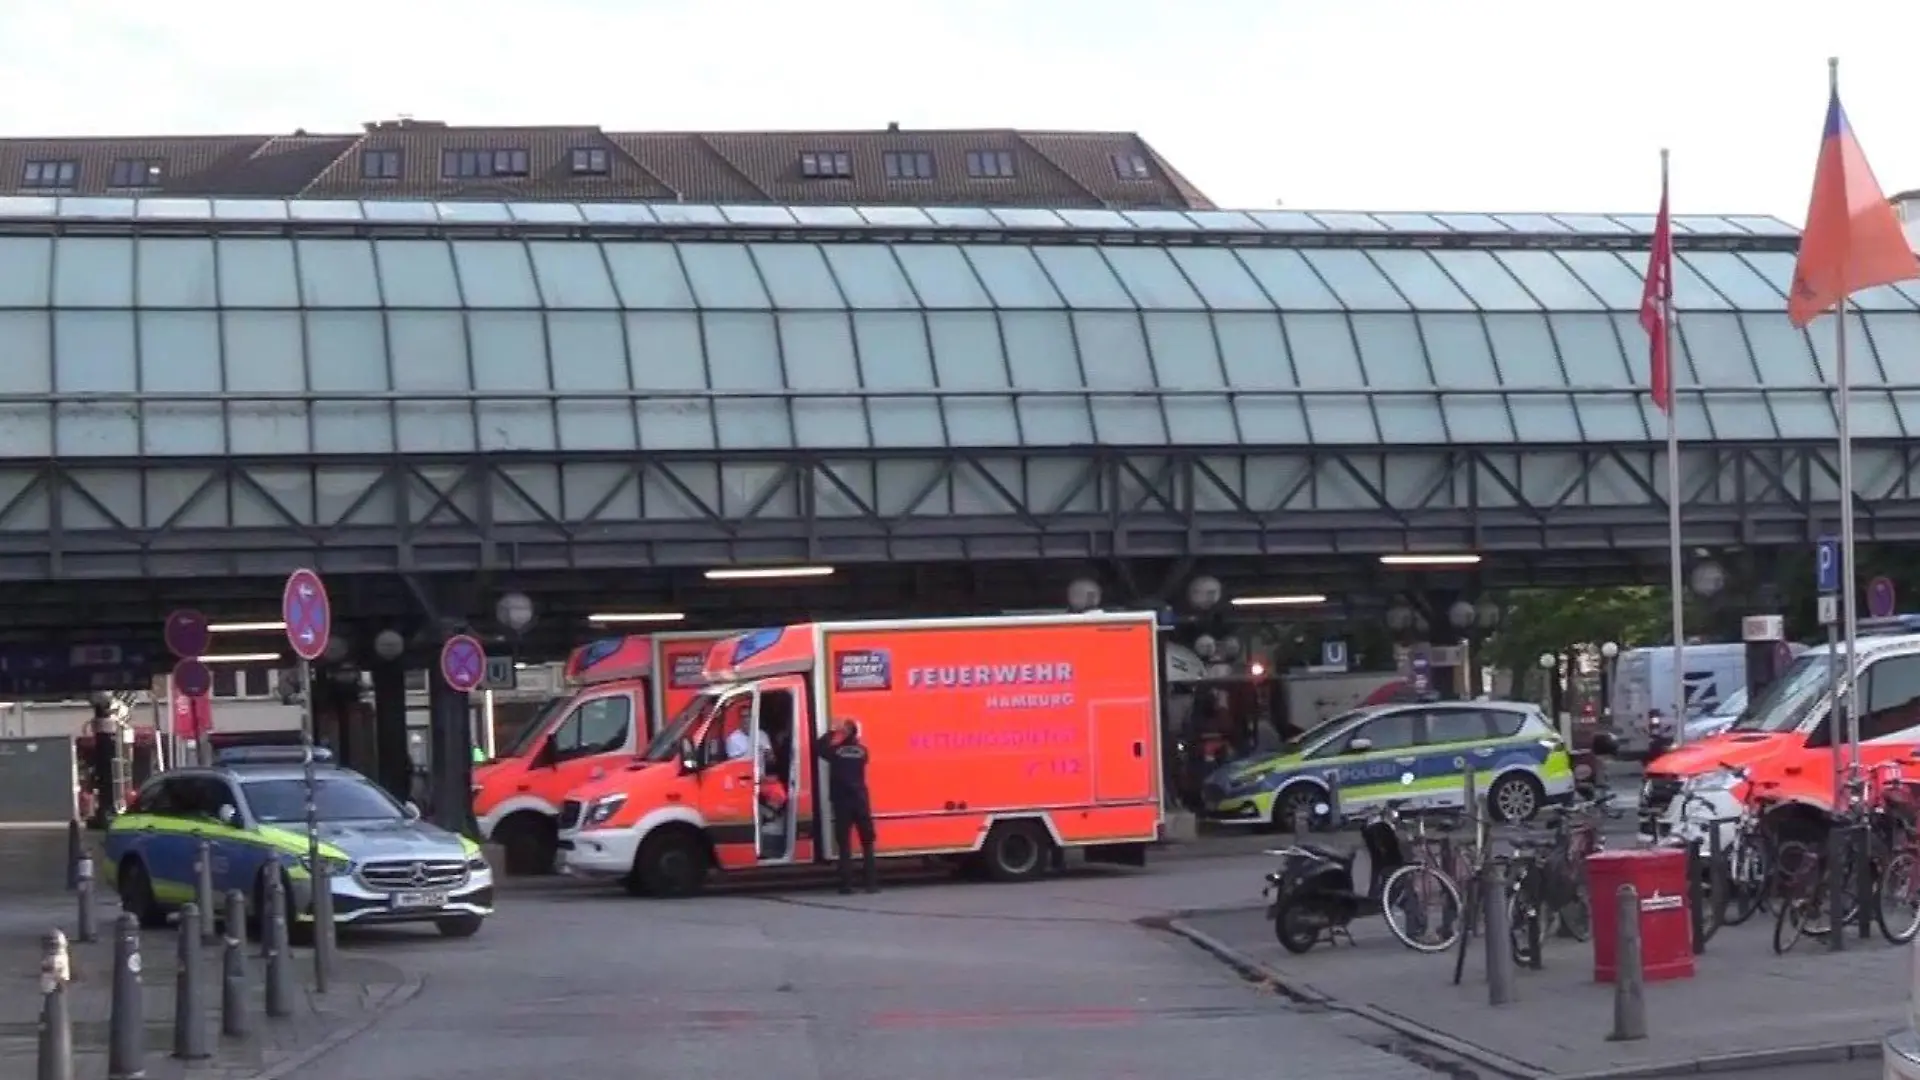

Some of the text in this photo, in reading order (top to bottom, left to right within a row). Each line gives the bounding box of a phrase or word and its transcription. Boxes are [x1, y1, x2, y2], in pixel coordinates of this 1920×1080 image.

[1821, 544, 1831, 584] P
[1327, 642, 1342, 663] U
[908, 661, 1073, 687] FEUERWEHR
[987, 693, 1074, 709] HAMBURG
[1050, 759, 1080, 774] 112
